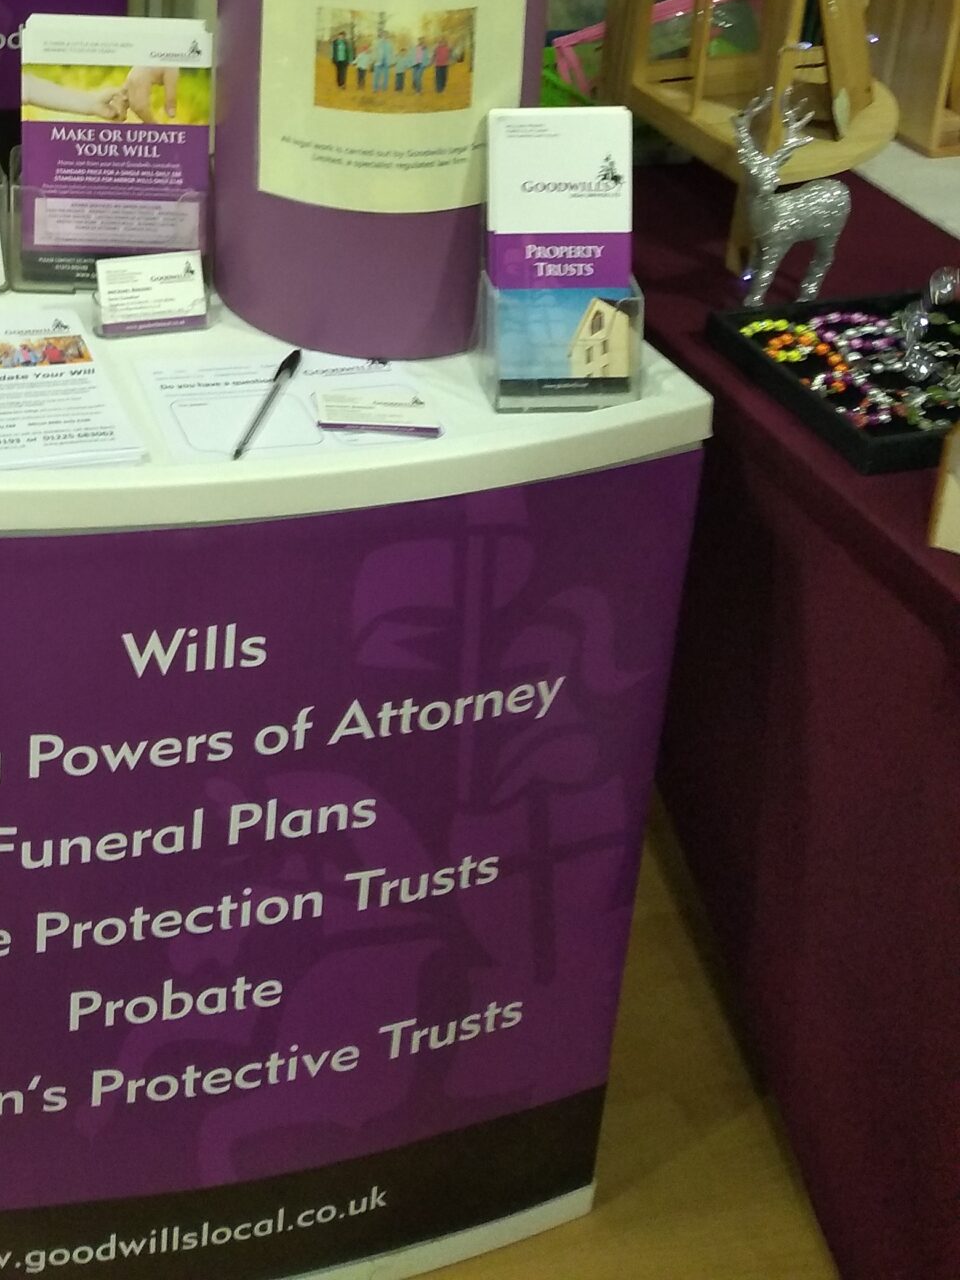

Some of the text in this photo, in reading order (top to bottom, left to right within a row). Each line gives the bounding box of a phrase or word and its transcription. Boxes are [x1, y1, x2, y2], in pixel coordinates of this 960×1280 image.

[51, 127, 186, 145] MAKE OR UPDATE
[76, 143, 160, 158] YOUR WILL
[525, 244, 605, 259] PROPERTY
[533, 262, 595, 277] TRUSTS
[69, 368, 96, 376] Will
[121, 622, 267, 678] Wills
[29, 729, 233, 780] Powers
[254, 705, 314, 756] of
[328, 675, 565, 747] Attorney
[228, 794, 378, 847] Plans
[36, 889, 323, 954] Protection
[344, 852, 501, 914] Trusts
[69, 977, 283, 1032] Probate
[91, 1041, 360, 1107] Protective
[379, 998, 524, 1062] Trusts
